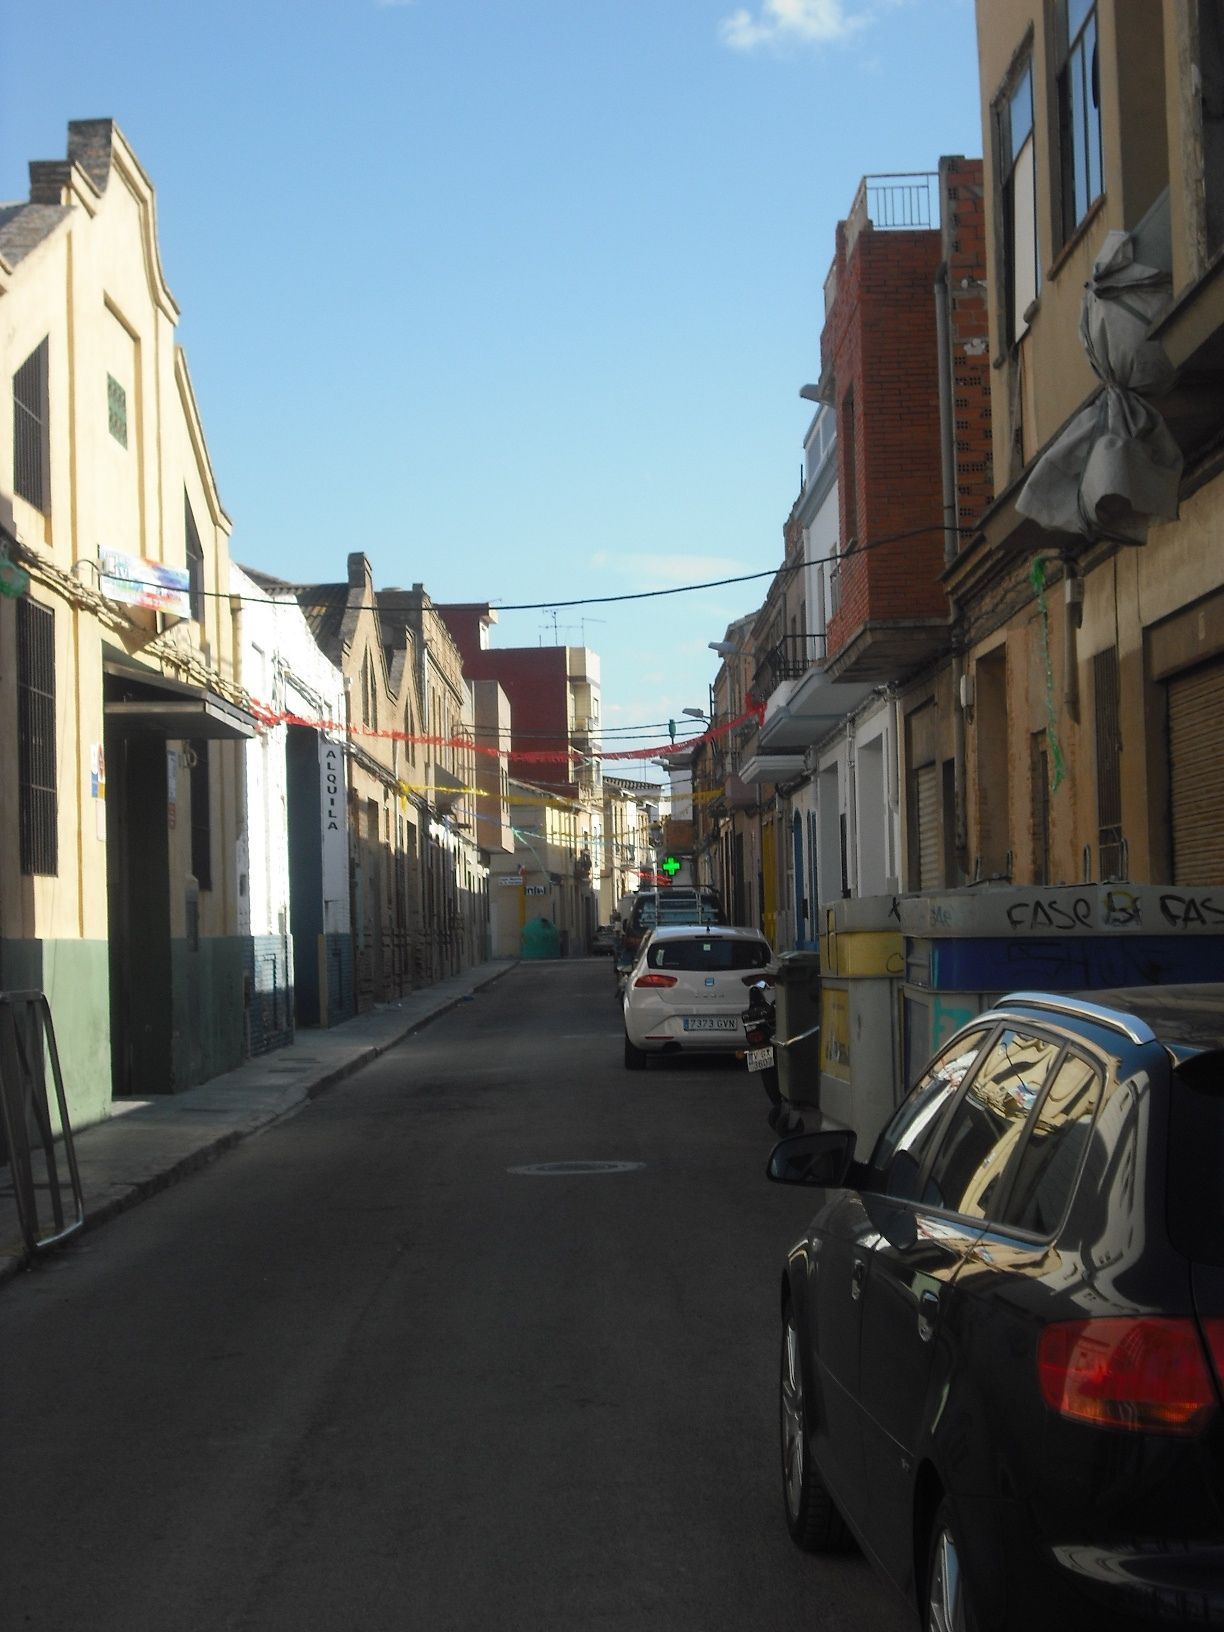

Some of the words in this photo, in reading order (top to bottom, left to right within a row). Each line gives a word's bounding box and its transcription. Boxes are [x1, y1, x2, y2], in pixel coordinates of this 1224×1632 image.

[326, 750, 338, 830] ALQUILA
[690, 1019, 712, 1028] 7373
[717, 1019, 735, 1028] GVN
